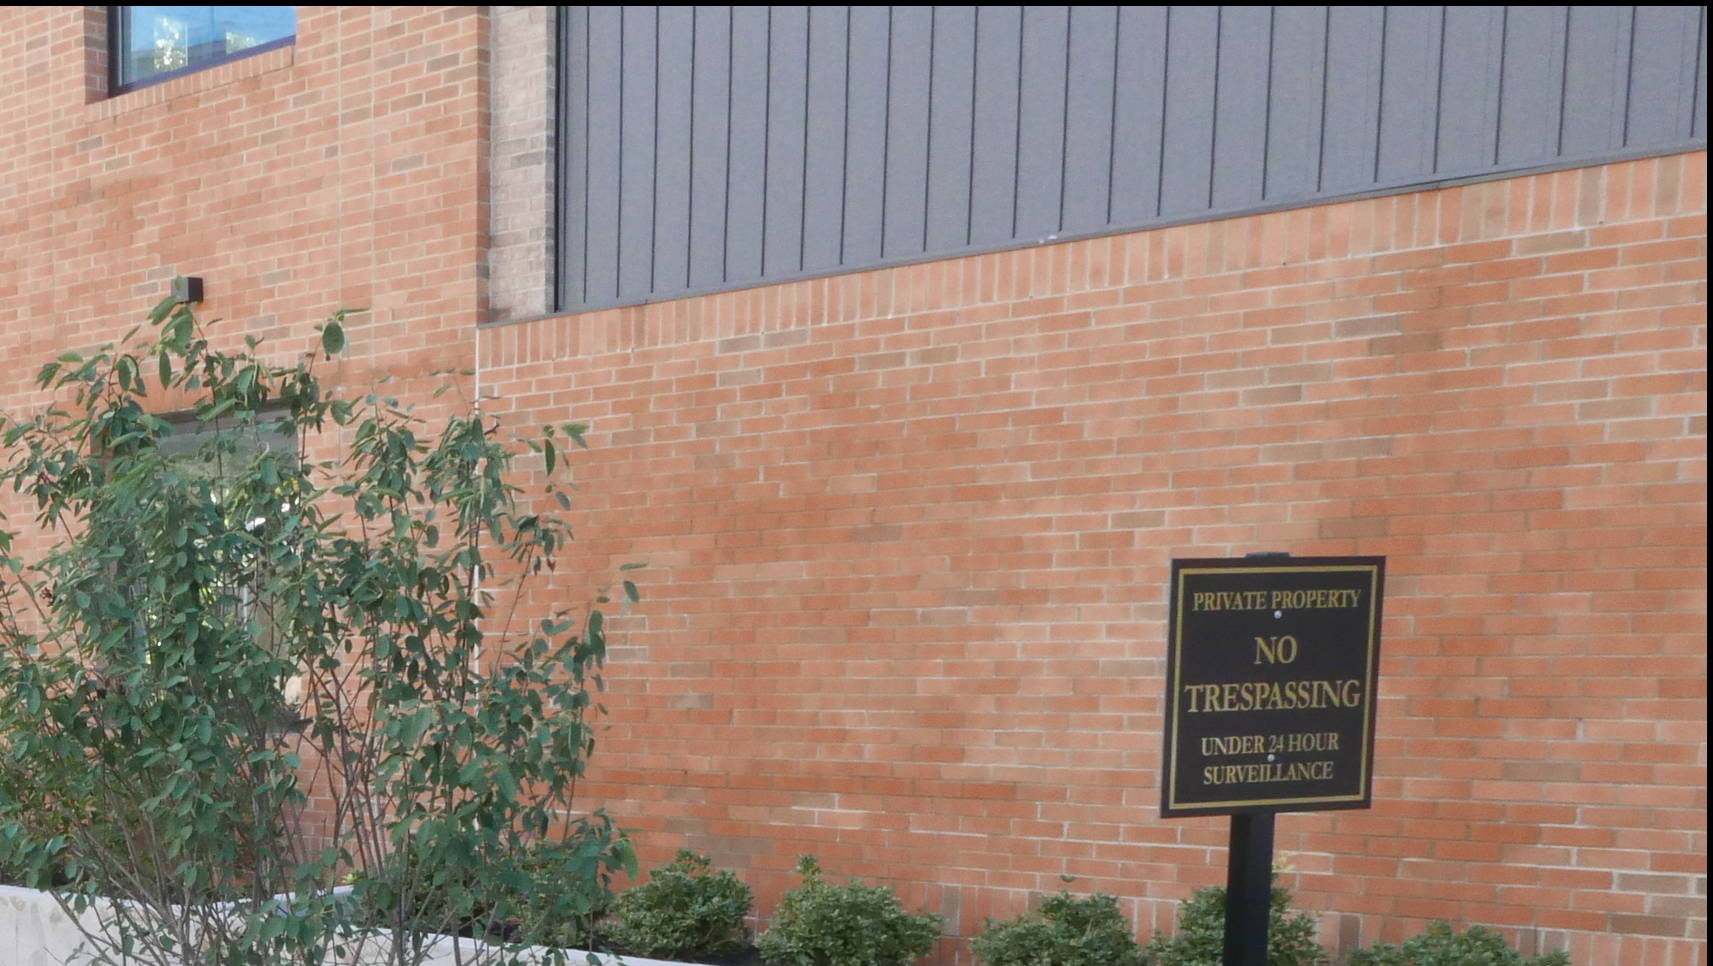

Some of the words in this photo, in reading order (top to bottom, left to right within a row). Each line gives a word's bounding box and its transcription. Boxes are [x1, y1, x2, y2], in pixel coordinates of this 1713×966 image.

[1192, 591, 1267, 611] PRIVATE
[1271, 589, 1362, 609] PROPERTY
[1254, 636, 1298, 664] NO
[1184, 680, 1361, 712] TRESPASSING
[1201, 735, 1264, 756] UNDER
[1268, 735, 1286, 753] 24
[1287, 733, 1340, 752] HOUR
[1203, 762, 1334, 785] SURVEILLANCE
